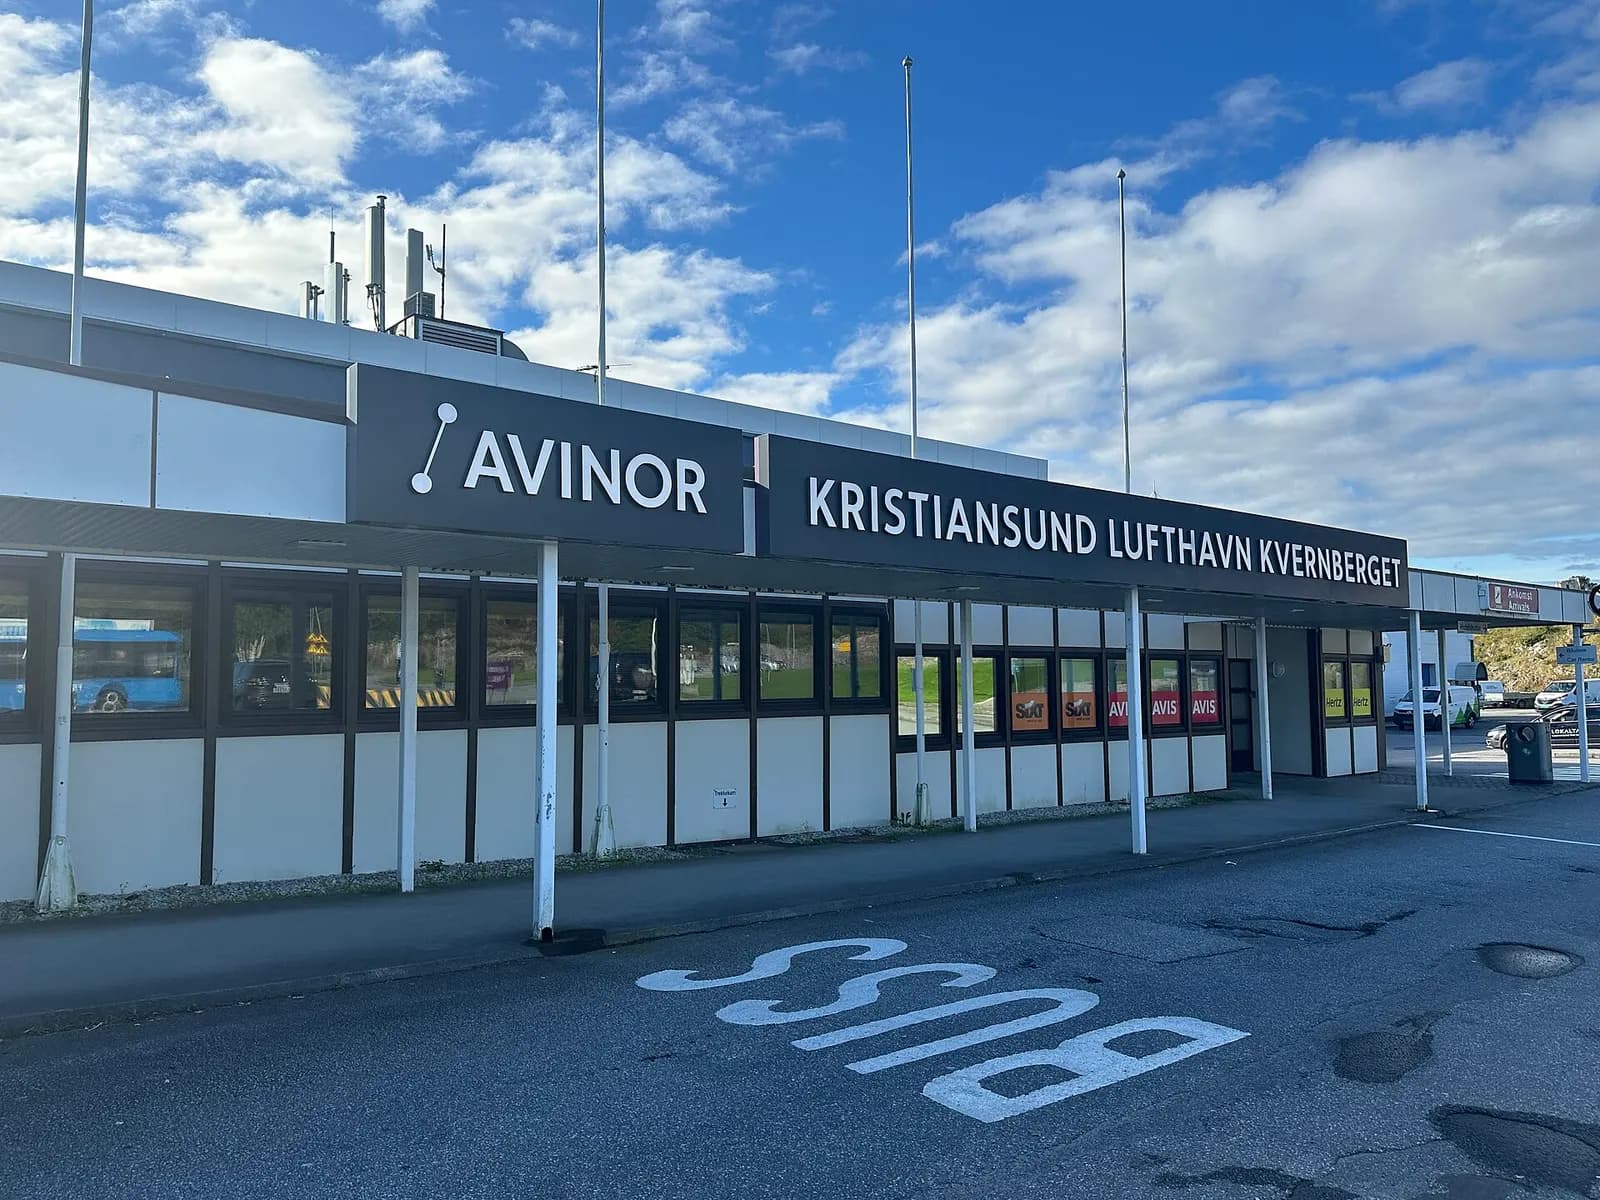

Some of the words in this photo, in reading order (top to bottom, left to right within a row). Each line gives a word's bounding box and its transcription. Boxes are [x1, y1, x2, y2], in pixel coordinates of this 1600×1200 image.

[463, 430, 708, 514] AVINOR
[808, 476, 1097, 555] KRISTIANSUND
[1108, 518, 1252, 572] LUFTHAVN
[1259, 538, 1401, 588] KVERNBERGET
[1108, 701, 1129, 717] AVI
[1151, 700, 1177, 716] AVIS
[1193, 699, 1216, 715] AVIS
[1326, 696, 1343, 708] Hertz
[1353, 696, 1369, 707] Hertz
[635, 937, 1252, 1124] BUSS
